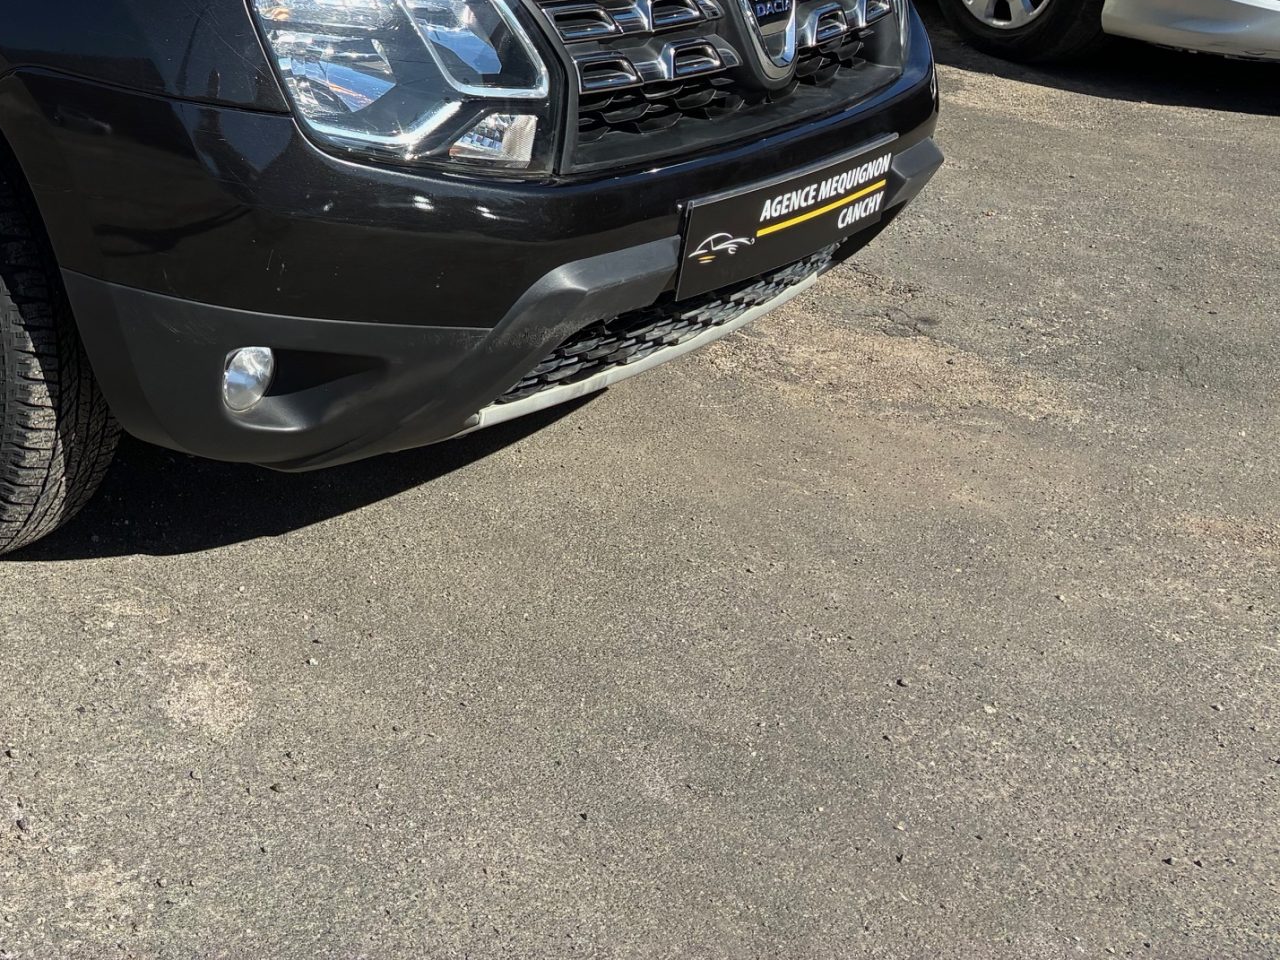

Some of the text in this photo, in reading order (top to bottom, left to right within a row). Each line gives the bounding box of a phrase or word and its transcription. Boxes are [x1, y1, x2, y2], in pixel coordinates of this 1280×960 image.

[759, 152, 892, 222] AGENCE MEQUIGNON
[836, 190, 885, 229] CANCHY
